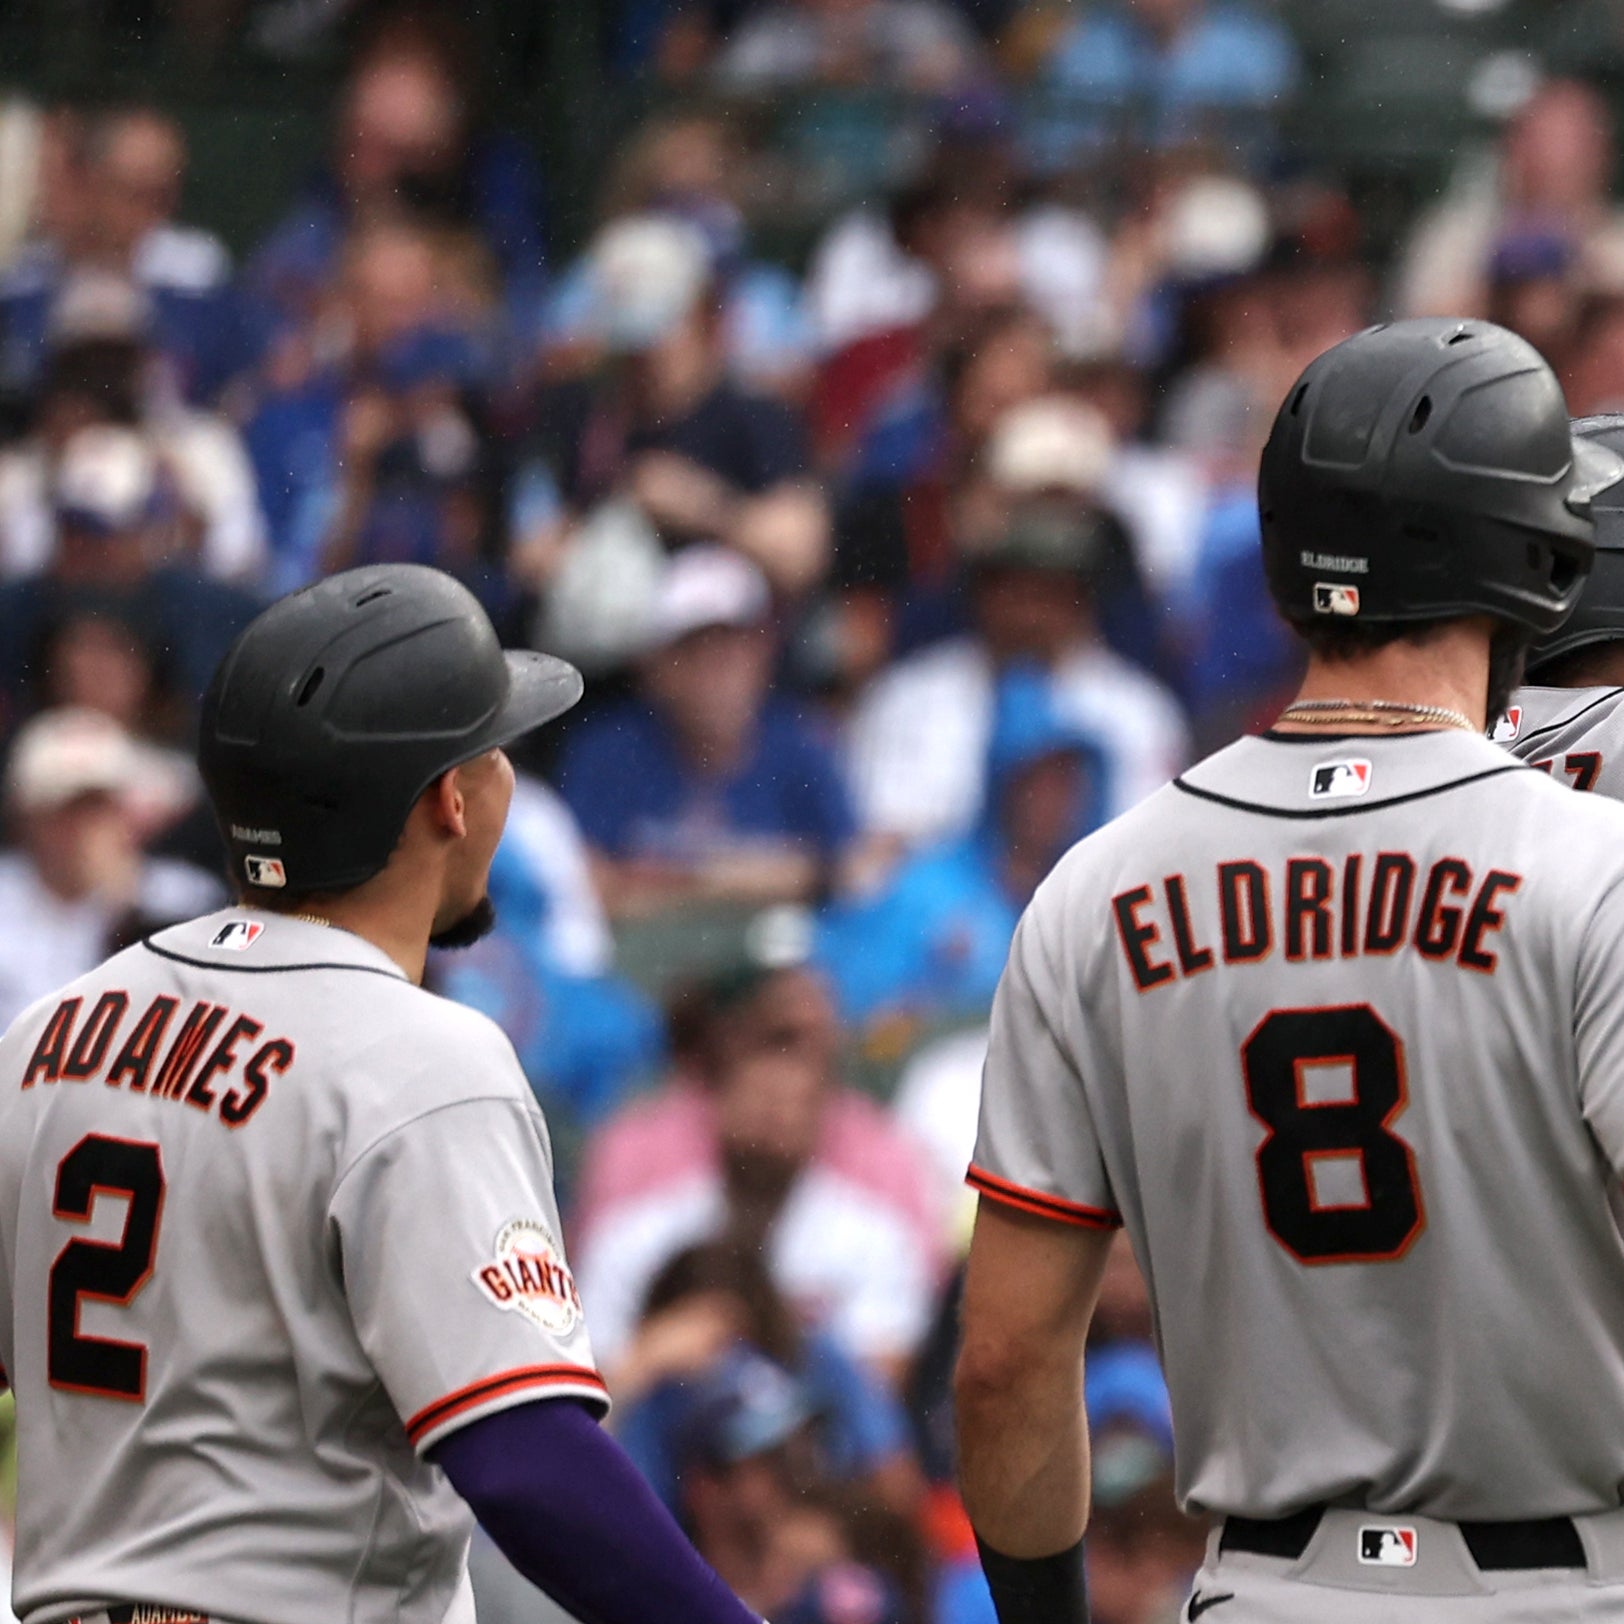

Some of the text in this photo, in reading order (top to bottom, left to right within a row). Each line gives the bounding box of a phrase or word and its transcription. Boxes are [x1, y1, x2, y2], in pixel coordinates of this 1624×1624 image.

[1112, 851, 1522, 994] ELDRIDGE
[22, 990, 296, 1129] ADAMES
[1240, 1002, 1428, 1266] 8
[48, 1131, 167, 1405] 2
